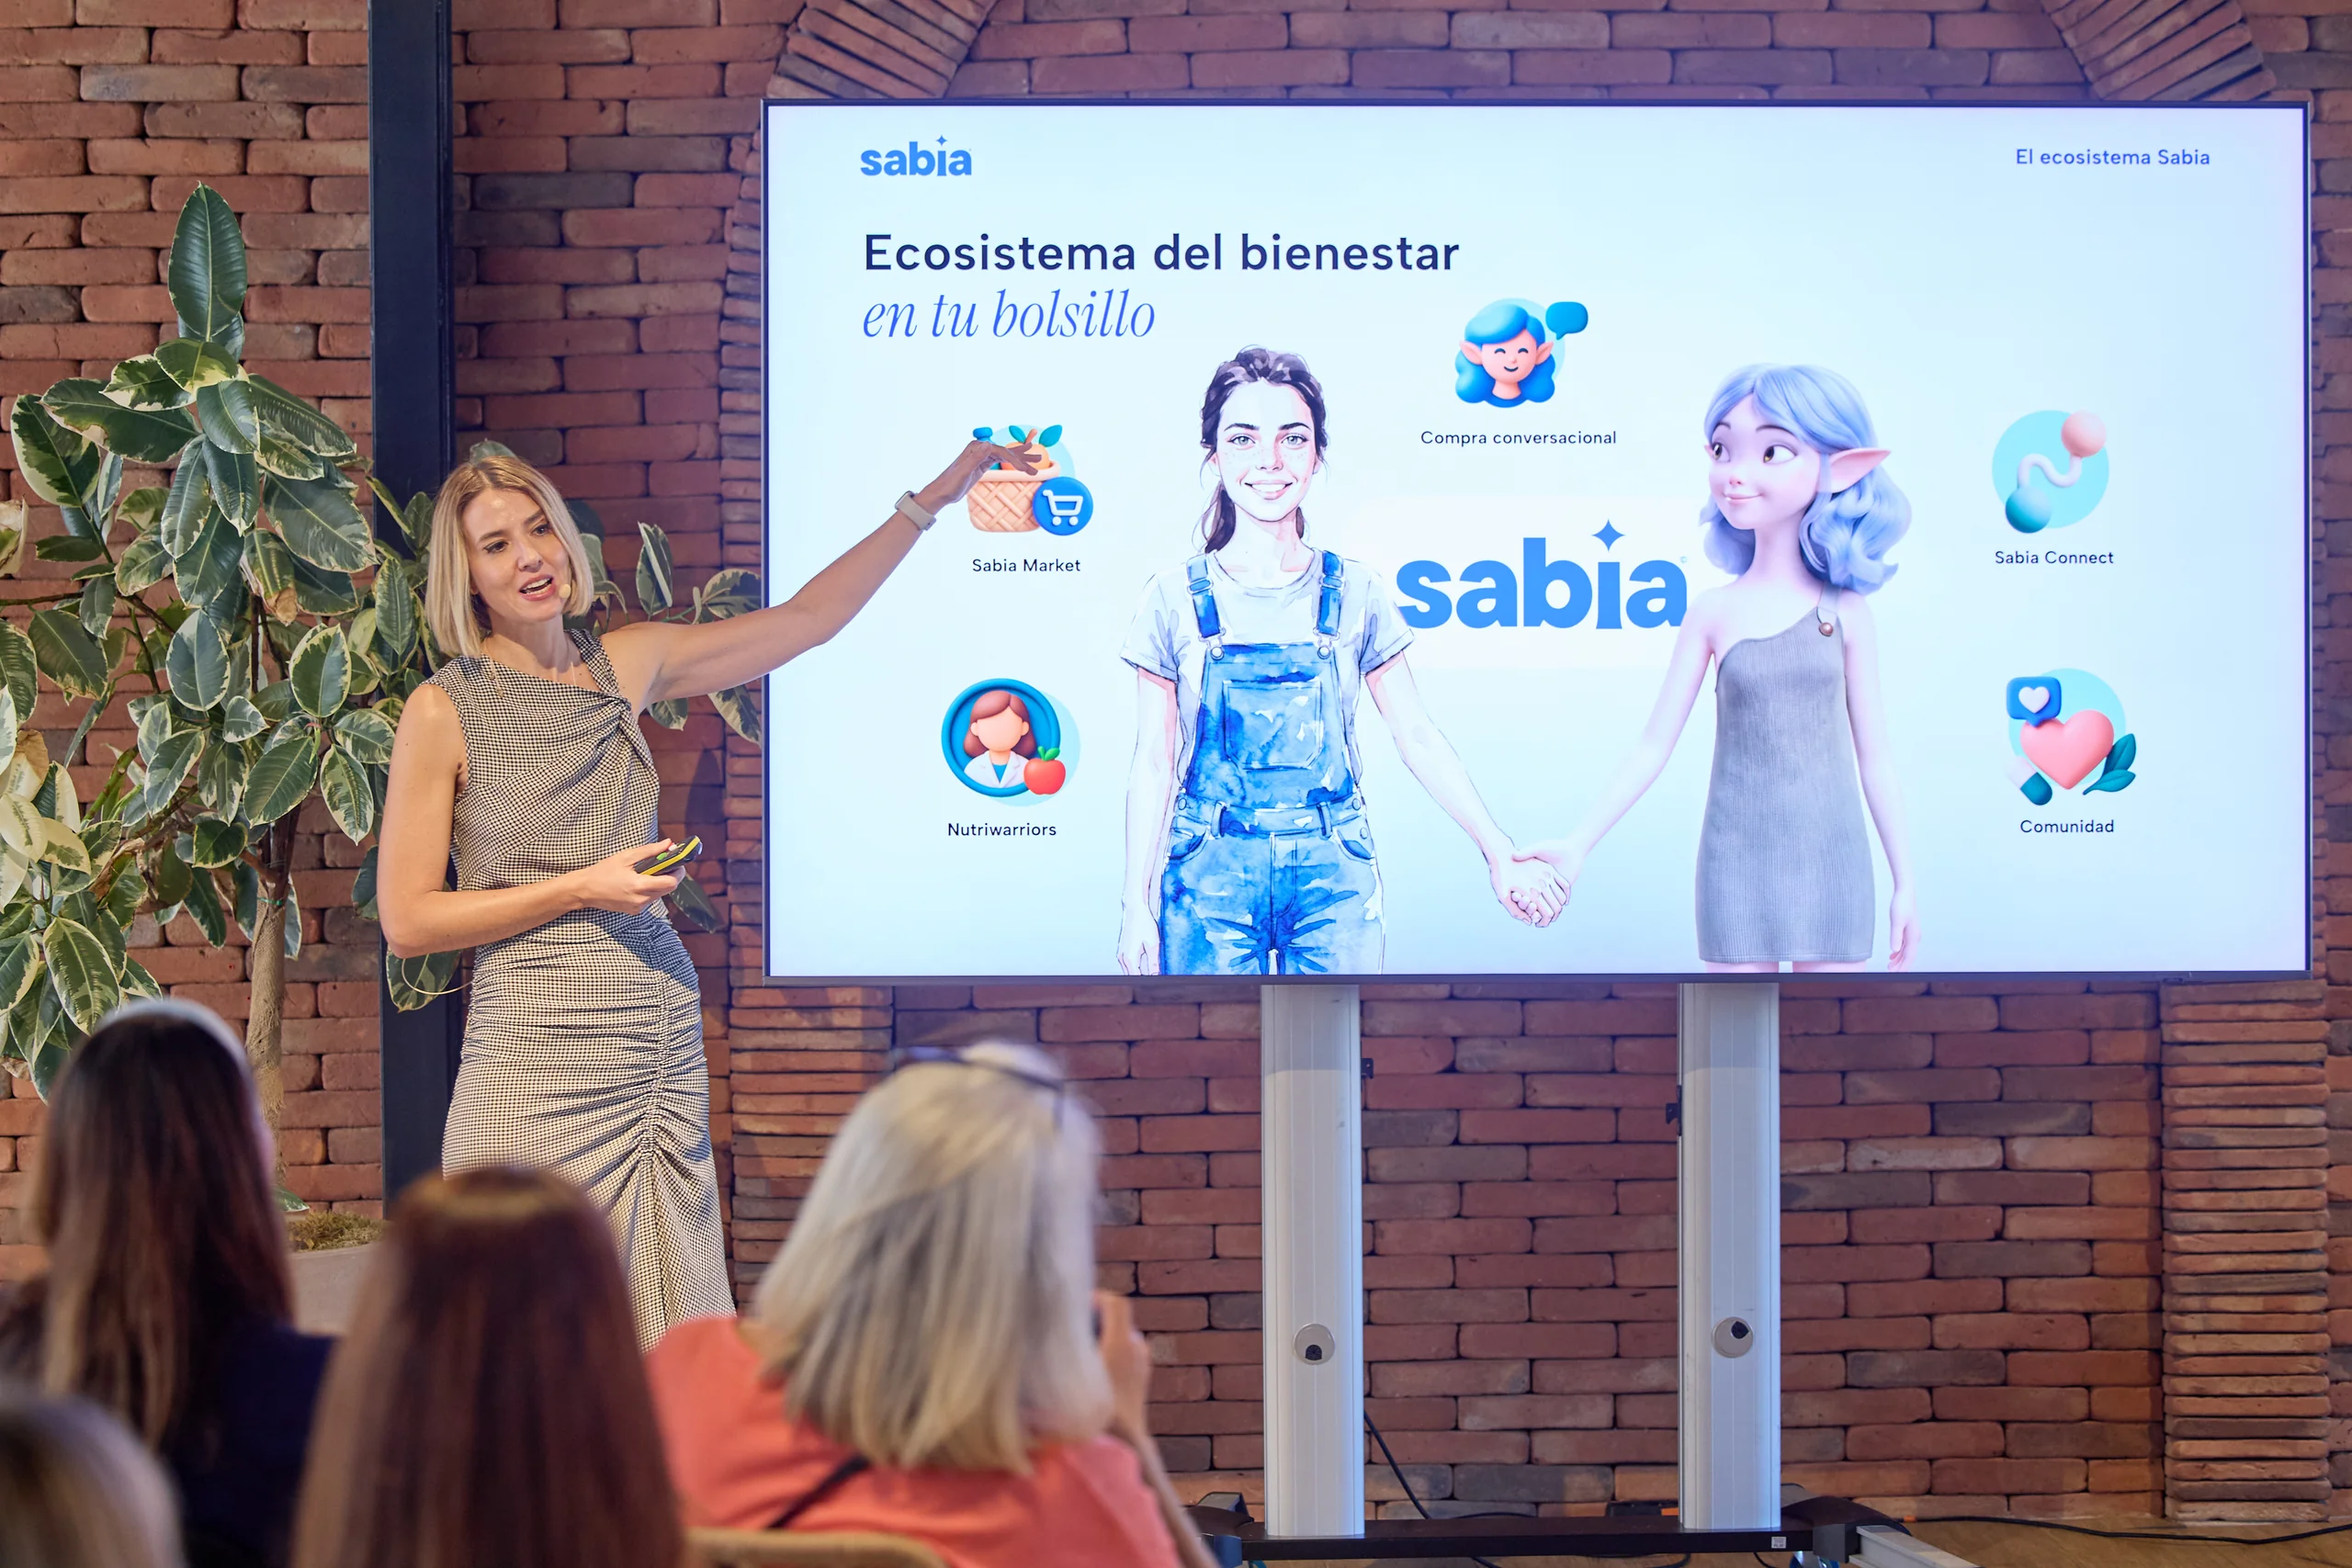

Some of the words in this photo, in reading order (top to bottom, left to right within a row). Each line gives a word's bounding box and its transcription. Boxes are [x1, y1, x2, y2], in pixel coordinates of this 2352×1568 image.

[860, 134, 972, 177] sabia
[2017, 148, 2033, 164] El
[2040, 149, 2151, 165] ecosistema
[2158, 149, 2211, 165] Sabia
[865, 232, 1136, 271] Ecosistema
[1153, 232, 1222, 271] del
[1241, 232, 1460, 271] bienestar
[863, 303, 918, 338] en
[932, 294, 978, 338] tu
[992, 288, 1155, 338] bolsillo
[1420, 430, 1487, 447] Compra
[1492, 430, 1616, 445] conversacional
[972, 558, 1017, 572] Sabia
[1023, 558, 1081, 572] Market
[1995, 550, 2040, 564] Sabia
[2044, 550, 2114, 564] Connect
[1396, 519, 1688, 629] sabia
[947, 822, 1057, 837] Nutriwarriors
[2019, 818, 2114, 833] Comunidad
